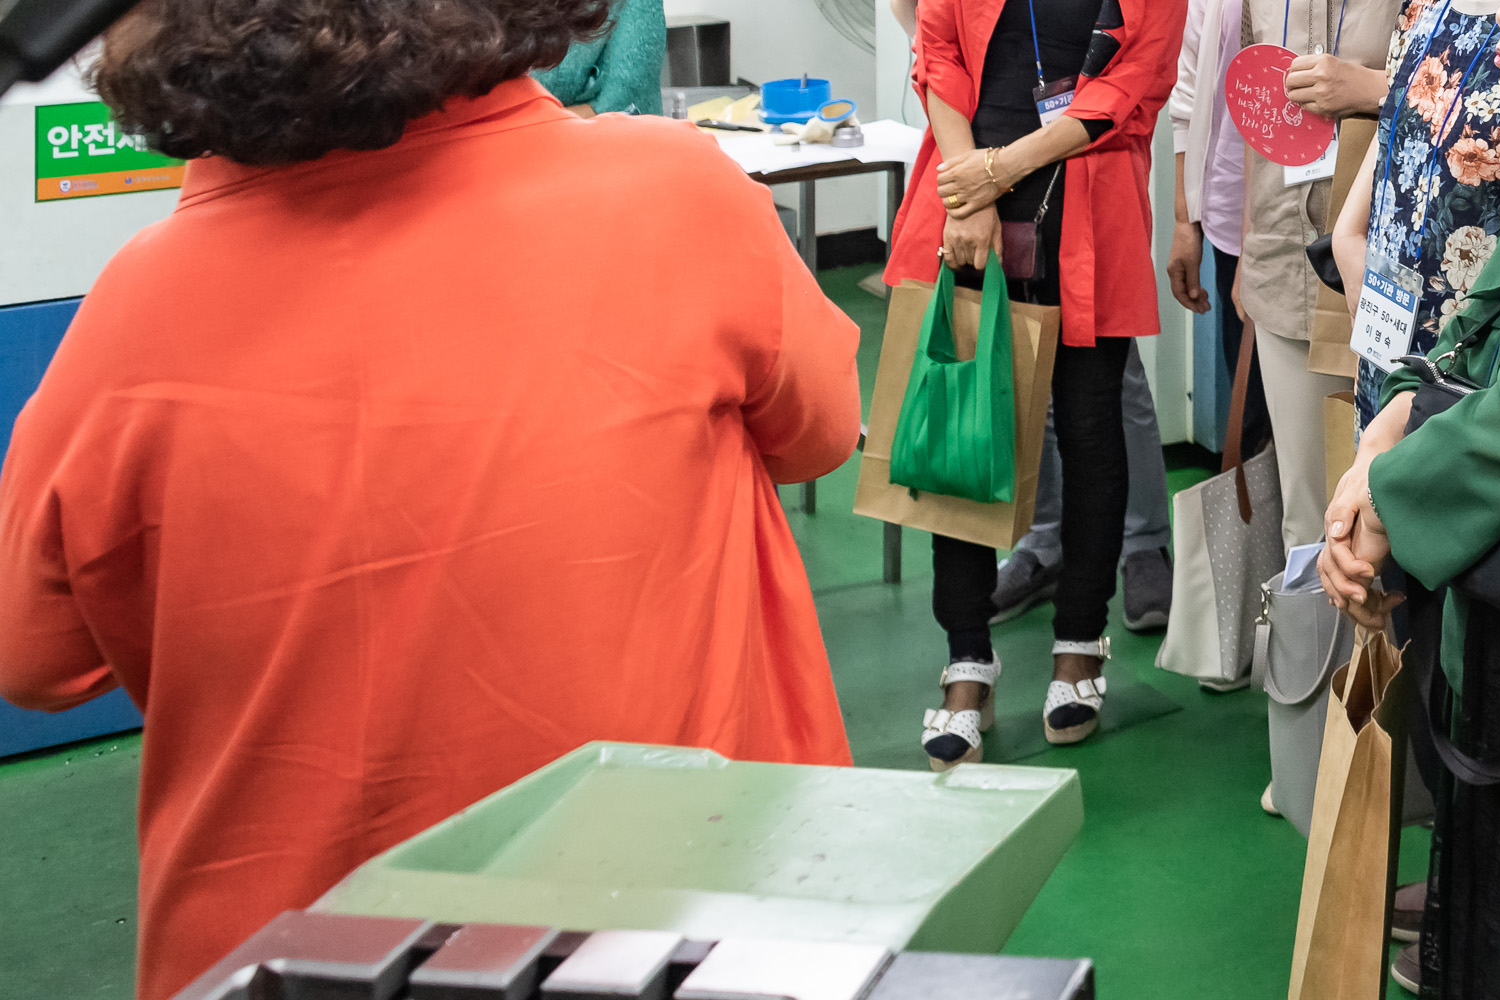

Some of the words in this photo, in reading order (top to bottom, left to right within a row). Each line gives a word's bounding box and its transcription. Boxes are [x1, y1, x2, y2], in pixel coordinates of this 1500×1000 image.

[1367, 273, 1394, 297] 50+기관
[1396, 286, 1411, 307] 방문
[1359, 297, 1379, 317] 광진구
[1380, 310, 1408, 335] 50+세대
